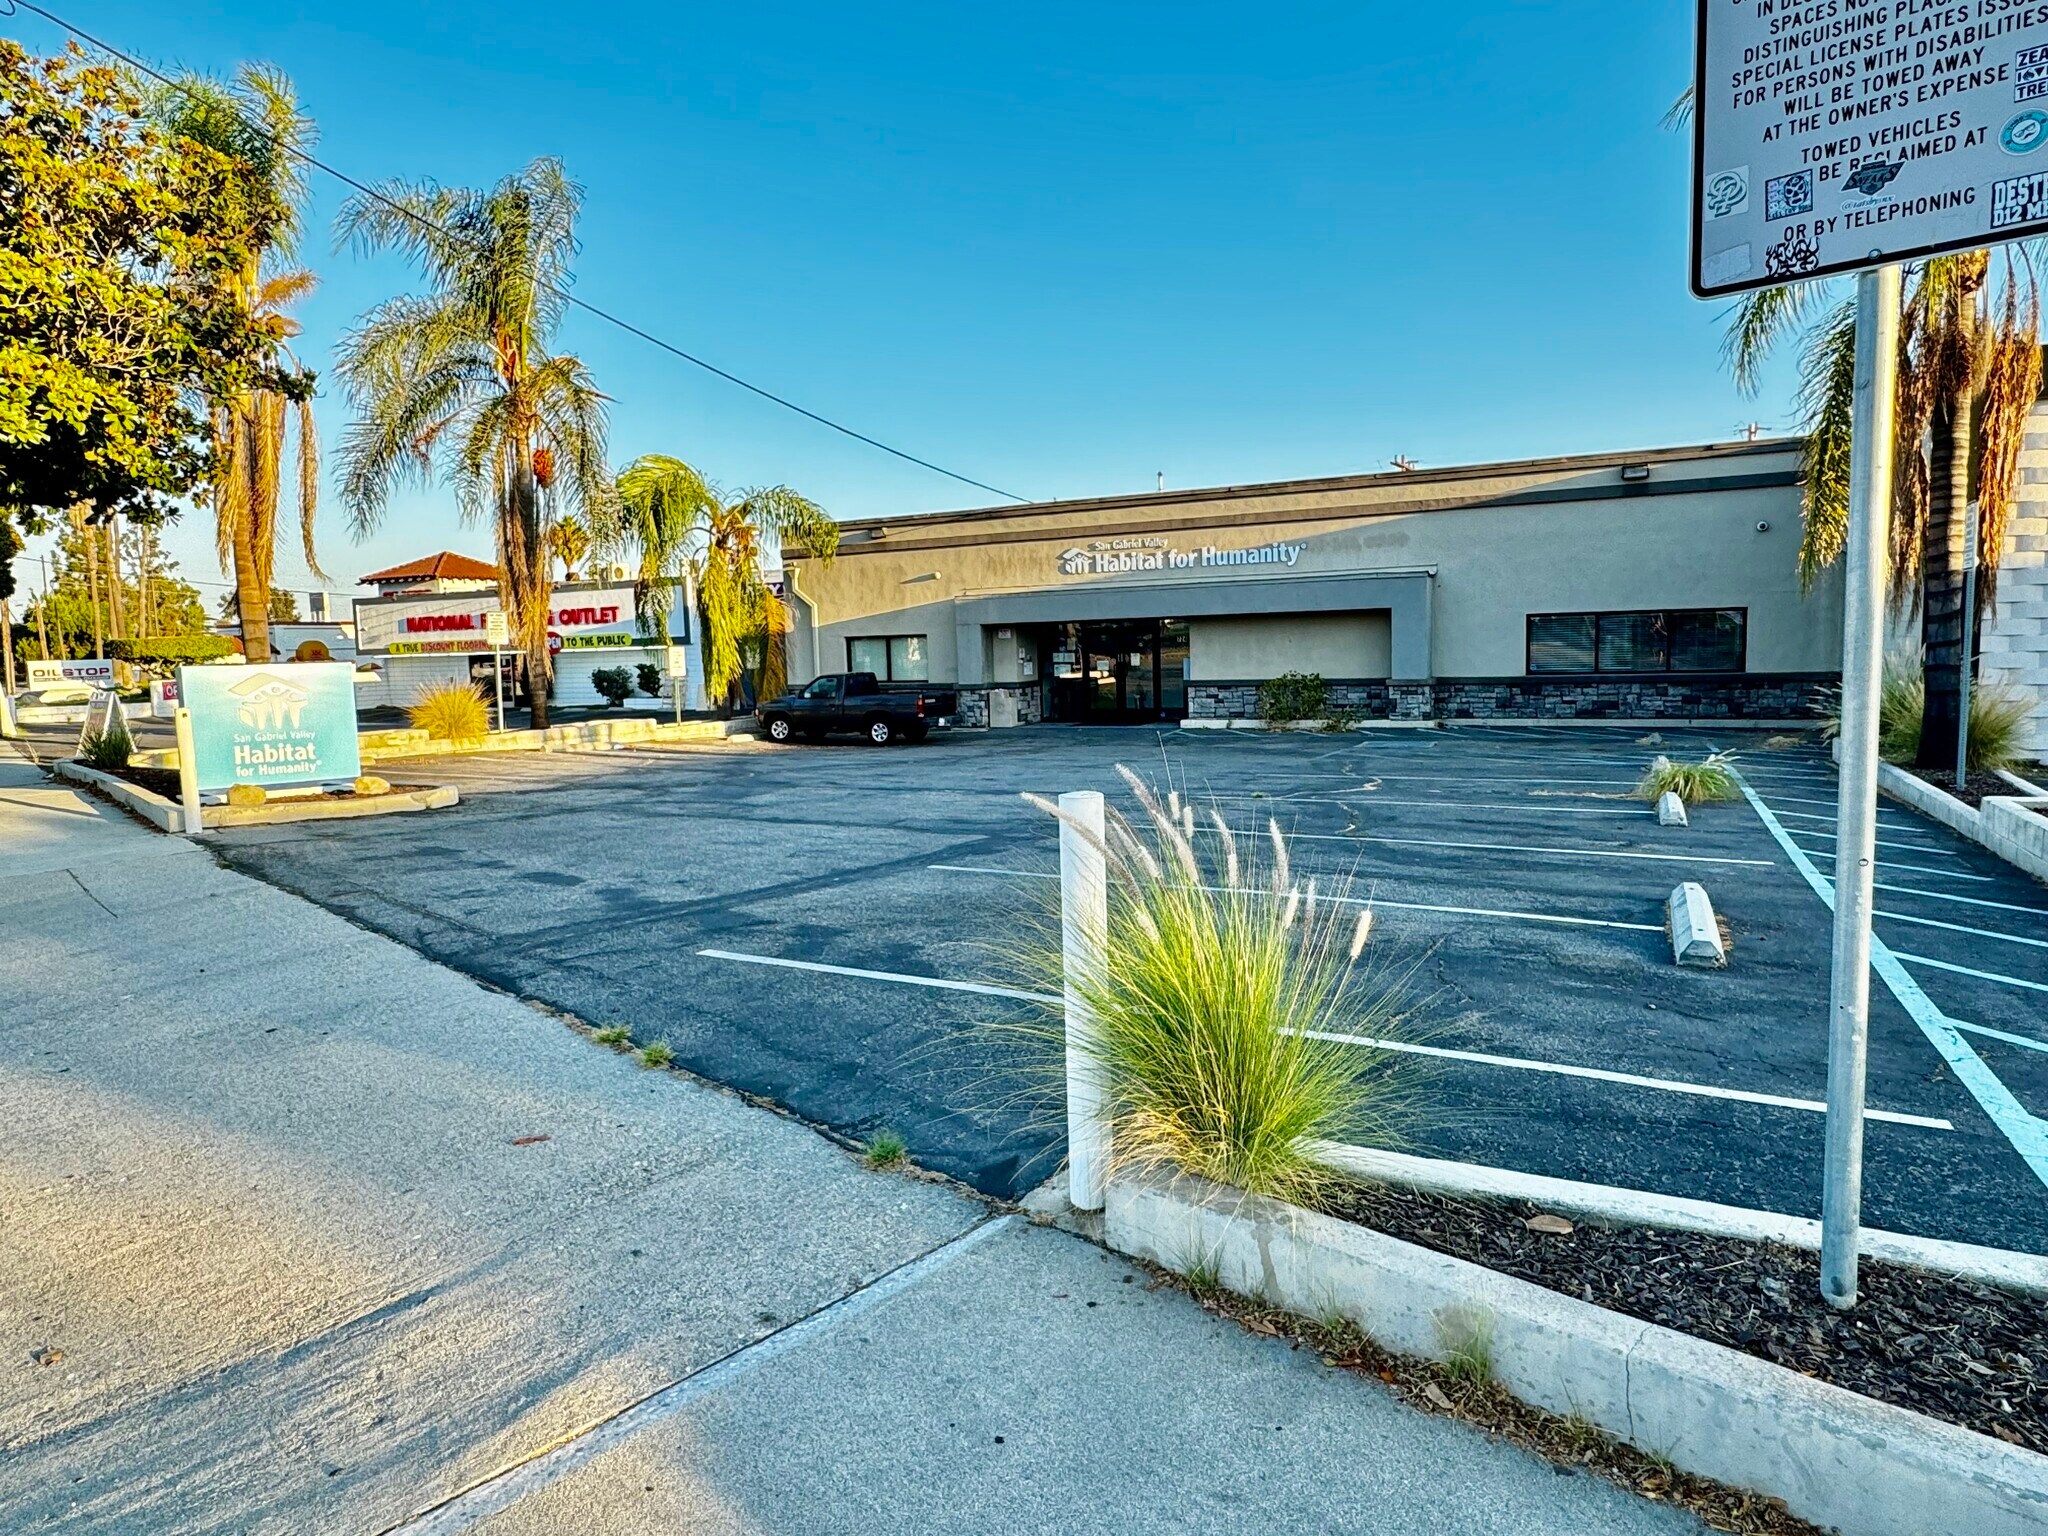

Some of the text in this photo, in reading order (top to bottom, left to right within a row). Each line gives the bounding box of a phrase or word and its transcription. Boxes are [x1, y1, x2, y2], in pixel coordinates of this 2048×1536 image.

[1757, 0, 1773, 18] IN
[1769, 0, 1838, 35] SPACES
[1732, 55, 1804, 88] SPECIAL
[1810, 29, 1887, 66] LICENSE
[1895, 5, 1969, 41] PLATES
[1744, 7, 1888, 64] DISTINGUISHING
[1733, 5, 2048, 109] FOR PERSONS WITH DISABILITIES
[1784, 46, 1985, 116] WILL BE TOWED AWAY
[1762, 62, 2009, 143] AT THE OWNER'S EXPENSE
[1801, 110, 1961, 164] TOWED VEHICLES
[1819, 161, 1842, 182] BE
[1963, 126, 1988, 148] AT
[1784, 224, 1807, 242] OR
[1814, 216, 1838, 236] BY
[1844, 186, 1976, 230] TELEPHONING
[1095, 538, 1169, 551] San Gabriel Valley
[1095, 550, 1164, 573] Habitat
[1168, 549, 1198, 569] for
[406, 613, 475, 633] NATIONAL
[559, 606, 619, 625] OUTLET
[402, 643, 419, 653] TRUE
[420, 641, 455, 653] DISCOUNT
[566, 637, 577, 646] TO
[580, 636, 594, 646] THE
[597, 635, 626, 646] PUBLIC
[233, 730, 315, 743] San Gabriel Valley
[233, 742, 316, 765] Habitat
[236, 766, 255, 777] for
